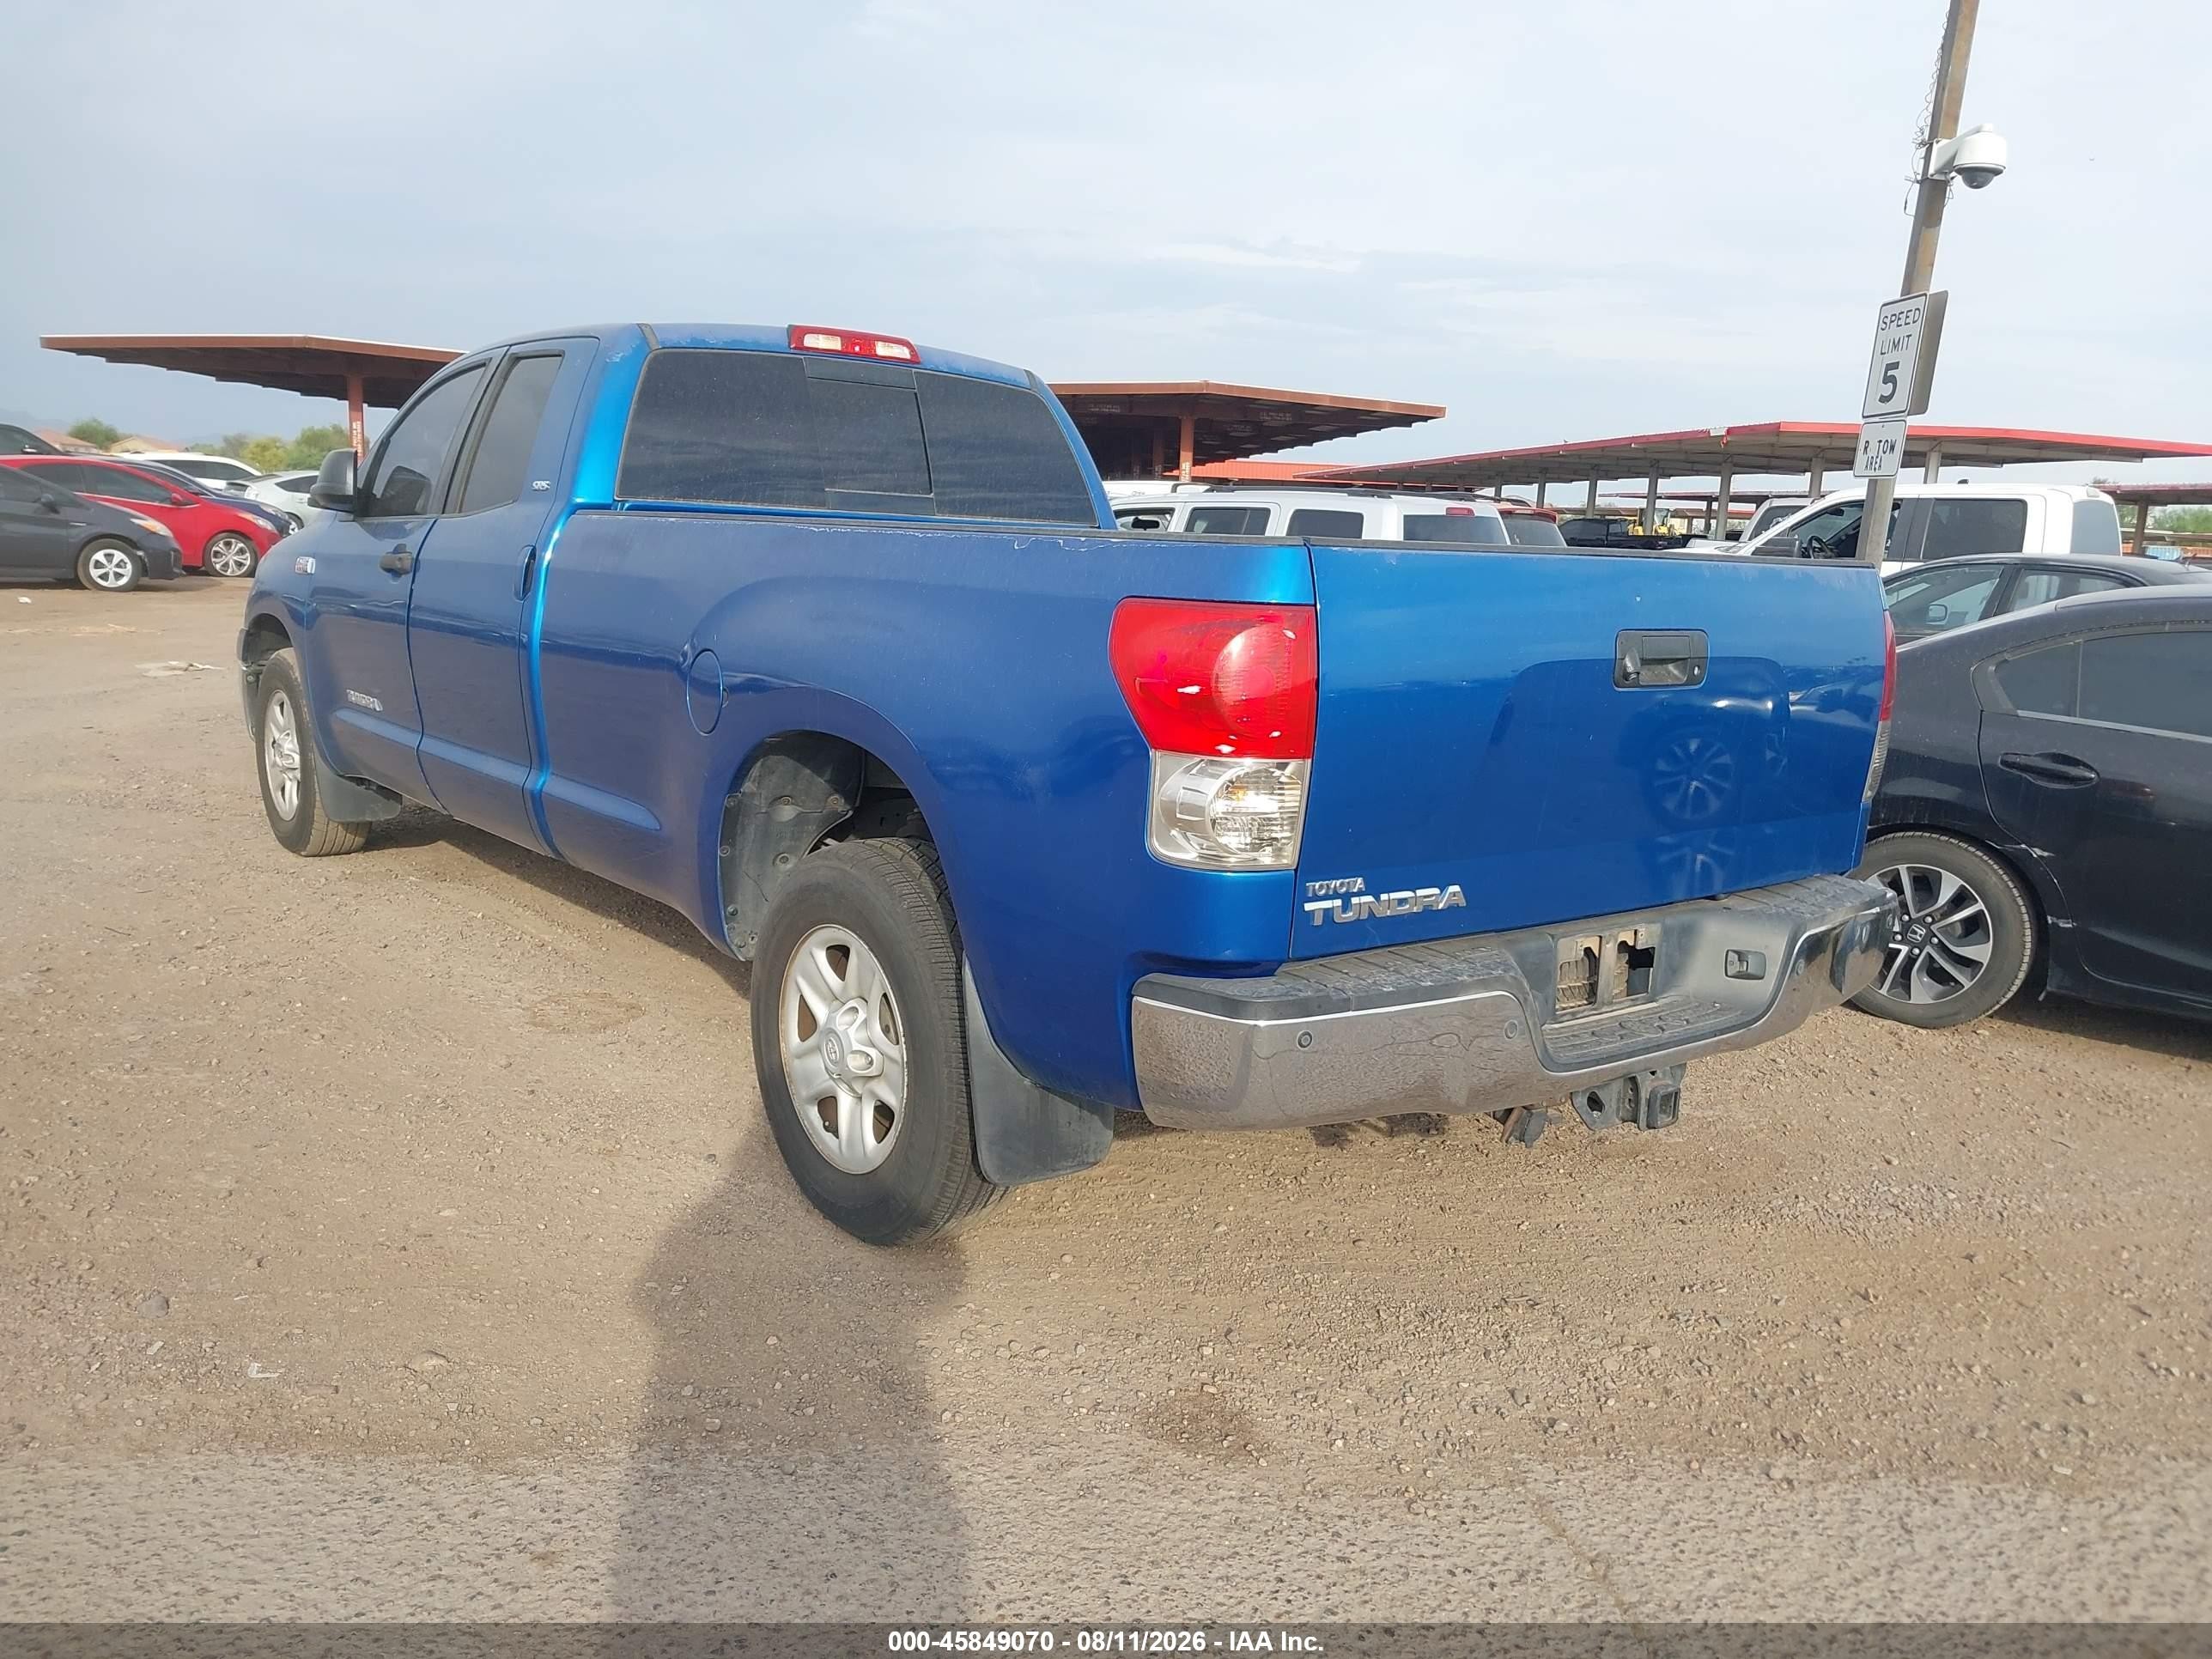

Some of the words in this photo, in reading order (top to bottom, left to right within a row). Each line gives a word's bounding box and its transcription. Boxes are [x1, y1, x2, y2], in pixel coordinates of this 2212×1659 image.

[1881, 307, 1921, 331] SPEED
[1880, 333, 1912, 356] LIMIT
[1878, 361, 1900, 404] 5
[1876, 439, 1897, 456] TOW
[1863, 455, 1883, 472] AREA
[1305, 877, 1365, 897] TOYOTA
[1304, 884, 1467, 927] TUNDRA
